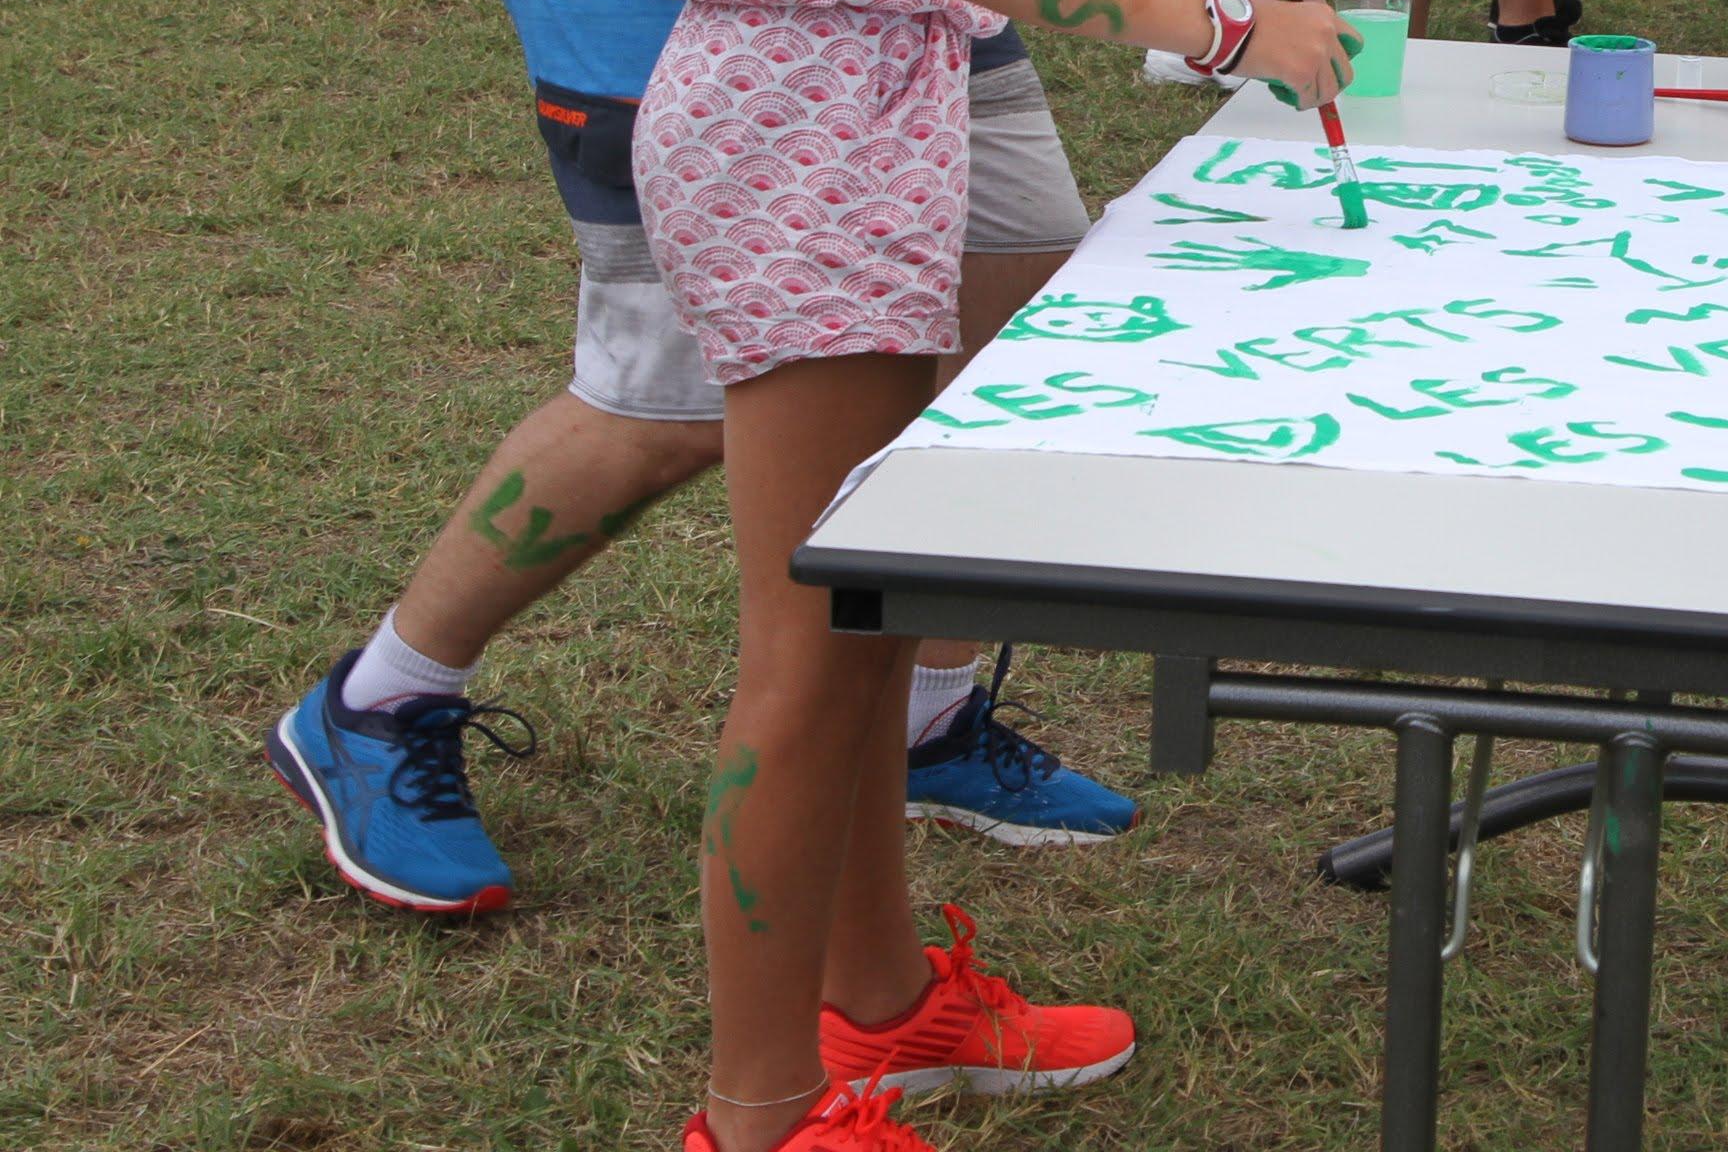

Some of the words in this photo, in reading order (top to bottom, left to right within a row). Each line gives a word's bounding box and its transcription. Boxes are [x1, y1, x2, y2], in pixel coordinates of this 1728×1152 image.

[920, 372, 1160, 430] LES
[1158, 298, 1564, 382] VERTS
[1345, 366, 1580, 421] LES
[1434, 420, 1669, 469] LES
